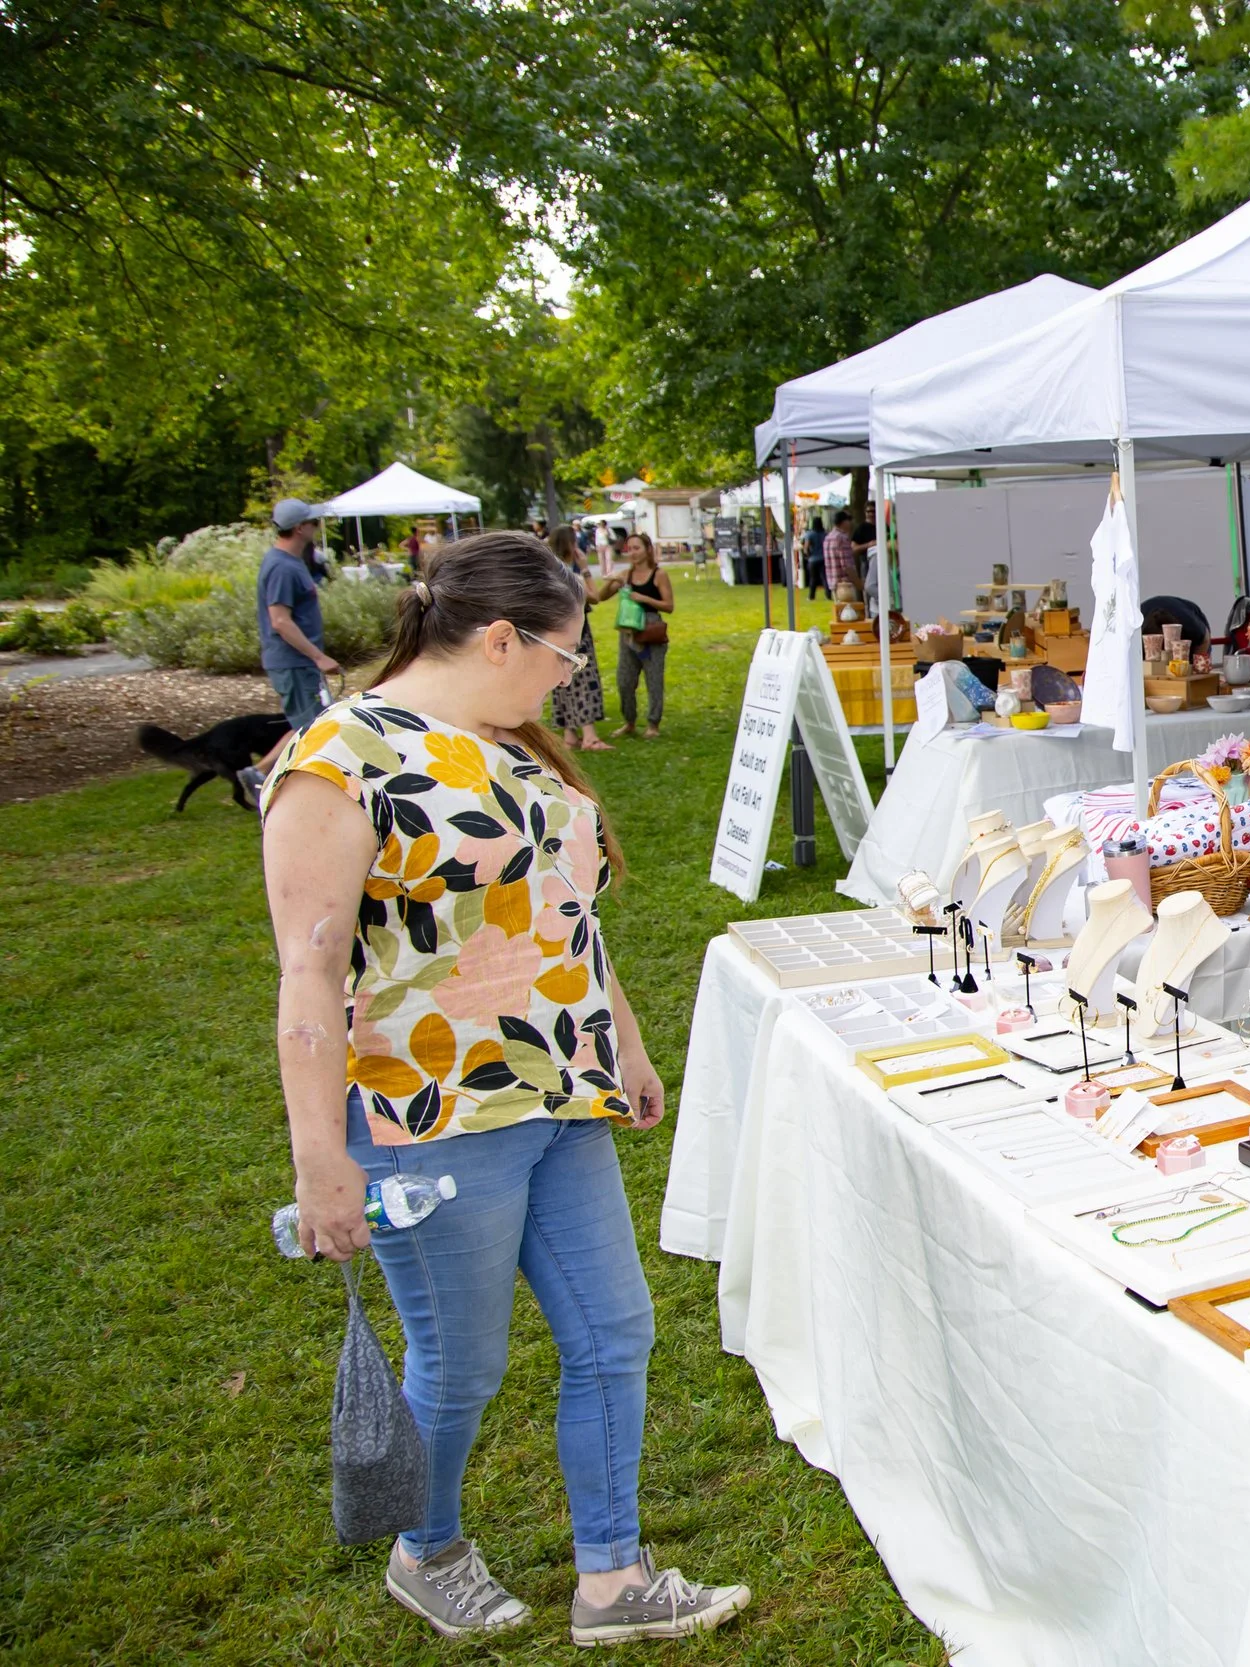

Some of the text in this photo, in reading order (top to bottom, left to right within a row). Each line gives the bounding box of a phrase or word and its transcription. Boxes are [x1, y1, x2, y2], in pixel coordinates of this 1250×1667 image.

[743, 713, 776, 740] Sign Up for
[739, 748, 768, 774] Adult and
[730, 782, 763, 812] Kid Fall Art
[726, 817, 752, 846] Classes!
